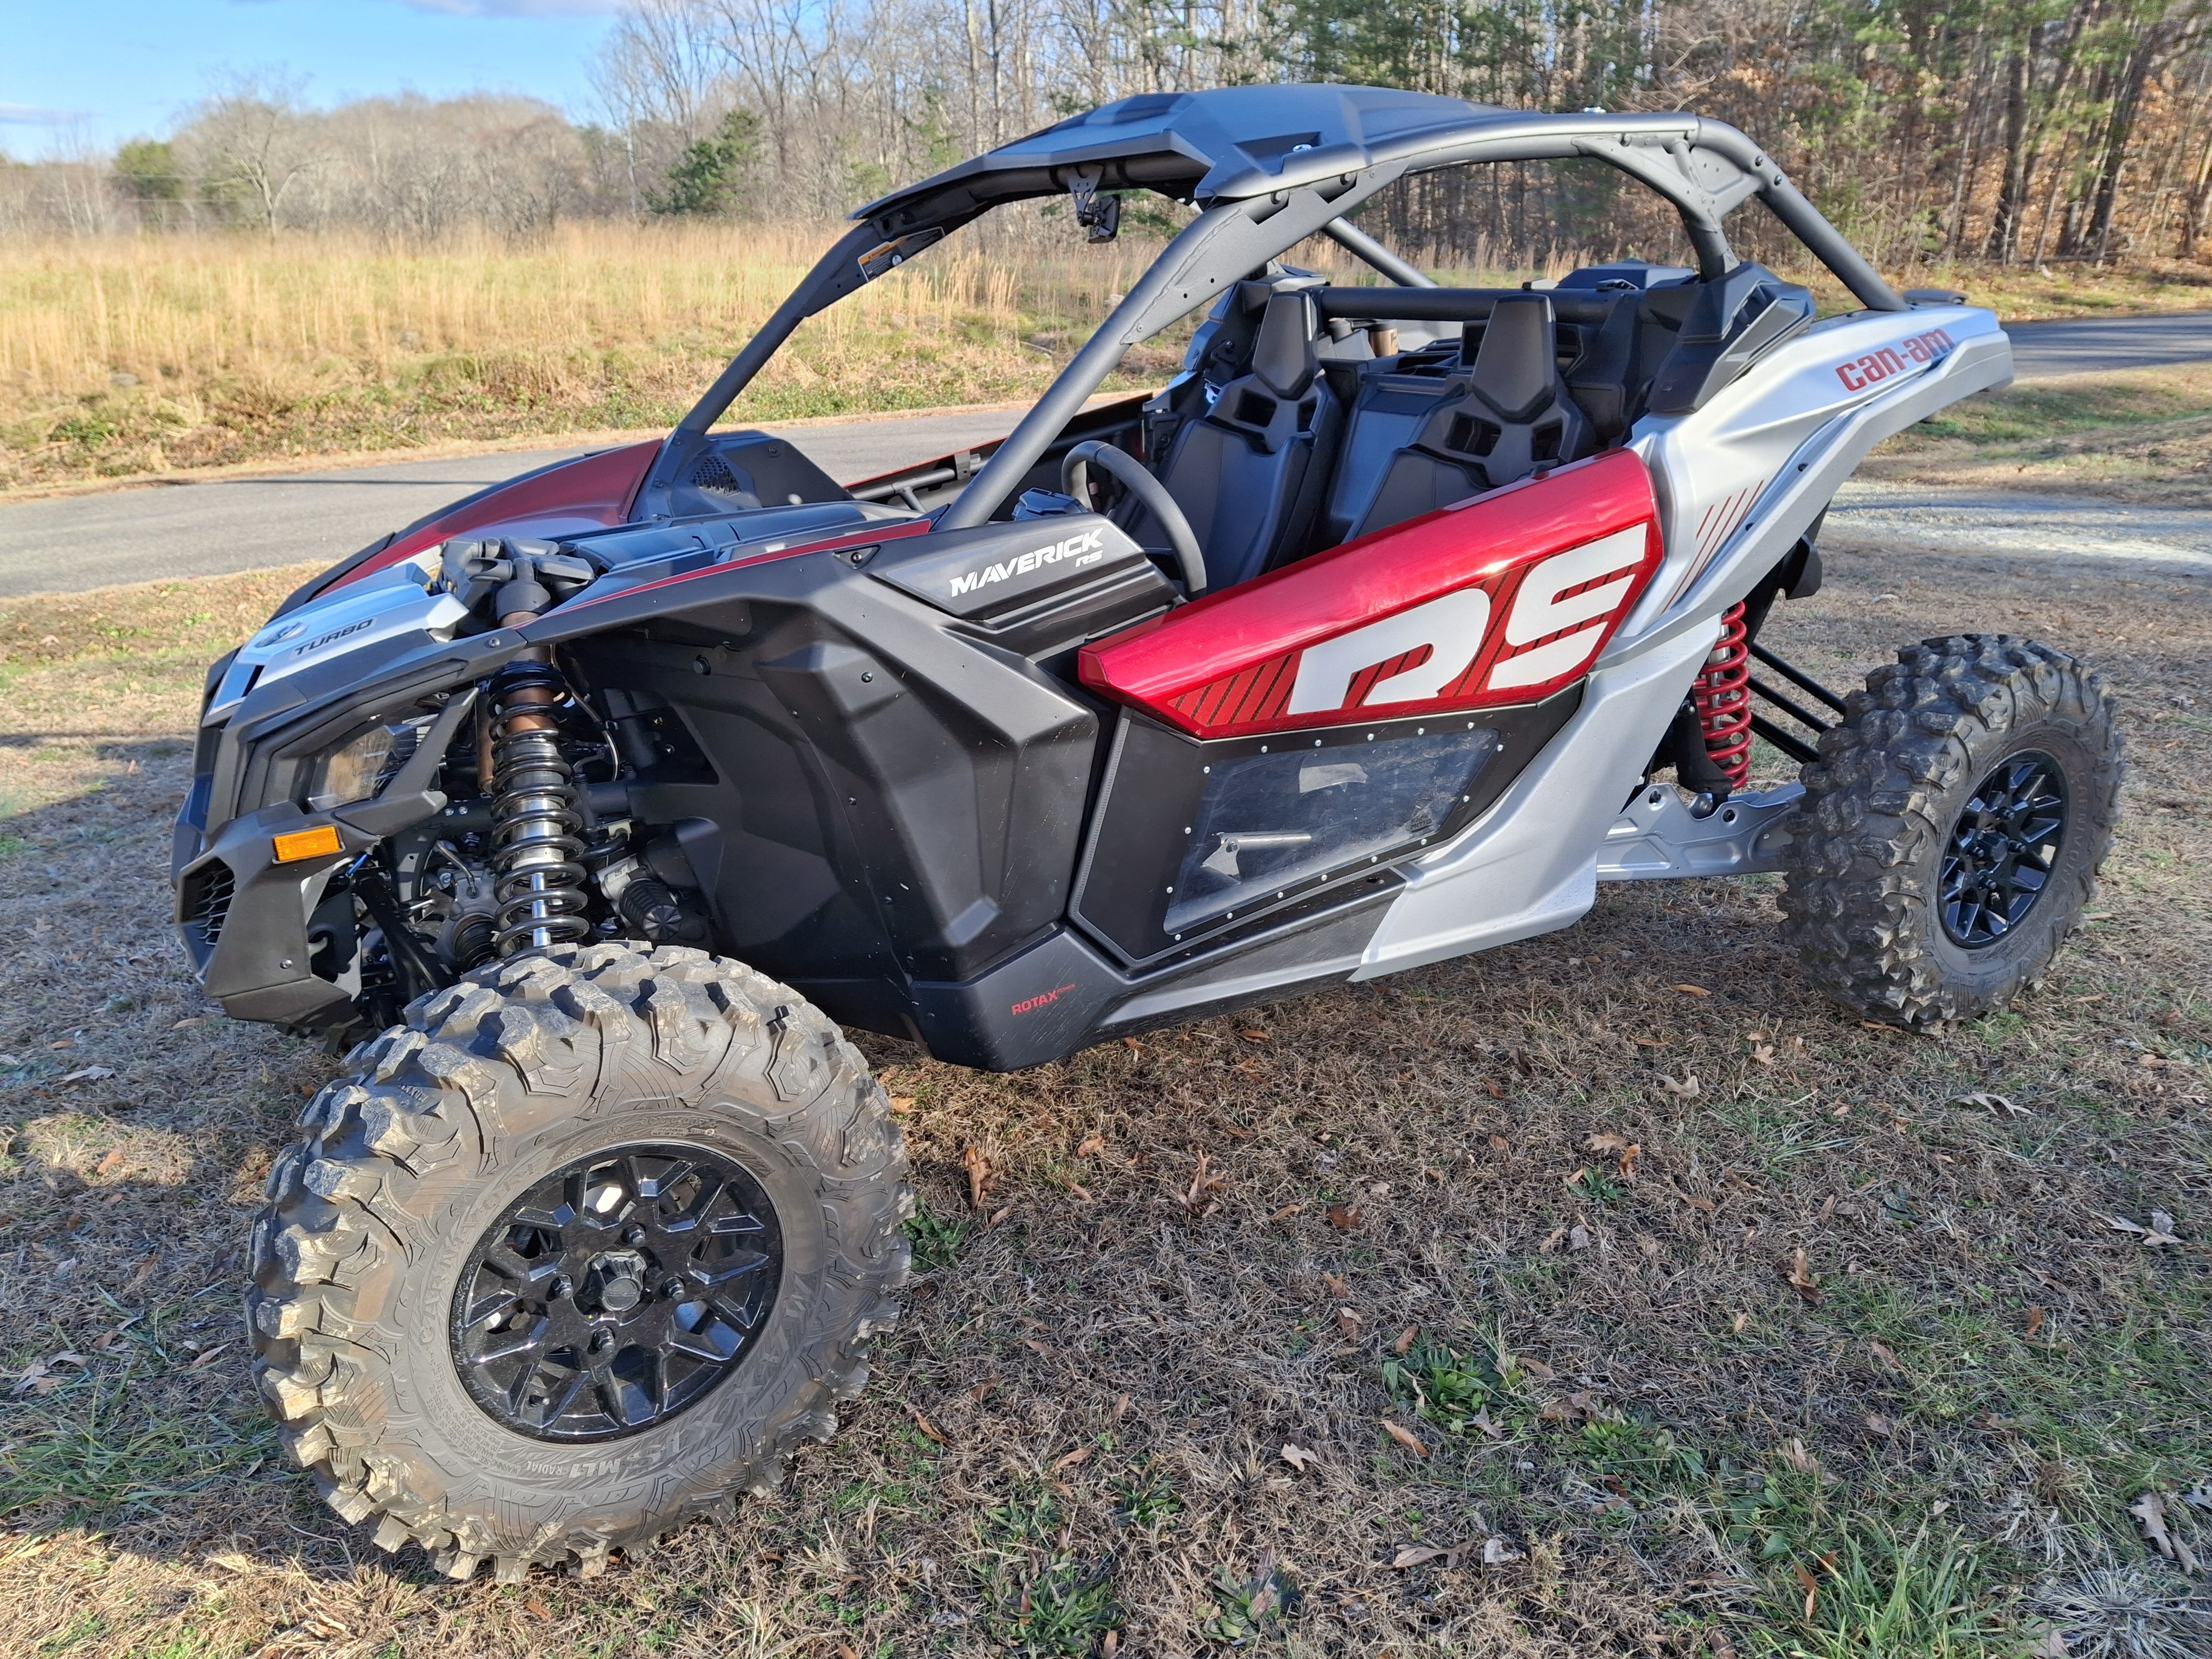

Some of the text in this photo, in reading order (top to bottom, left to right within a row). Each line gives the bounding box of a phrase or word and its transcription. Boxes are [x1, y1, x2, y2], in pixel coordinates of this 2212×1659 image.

[1835, 329, 1956, 391] can-am
[949, 528, 1104, 597] MAVERICK
[1075, 550, 1104, 567] RS
[1287, 523, 1647, 715] RS
[295, 619, 373, 655] TURBO
[1411, 819, 1432, 829] MOTO
[1012, 983, 1076, 1015] ROTAX POWER
[458, 1441, 480, 1458] VEHICLE
[473, 1442, 495, 1458] MANUAL
[523, 1460, 564, 1475] RADIAL
[568, 1456, 621, 1478] ML1
